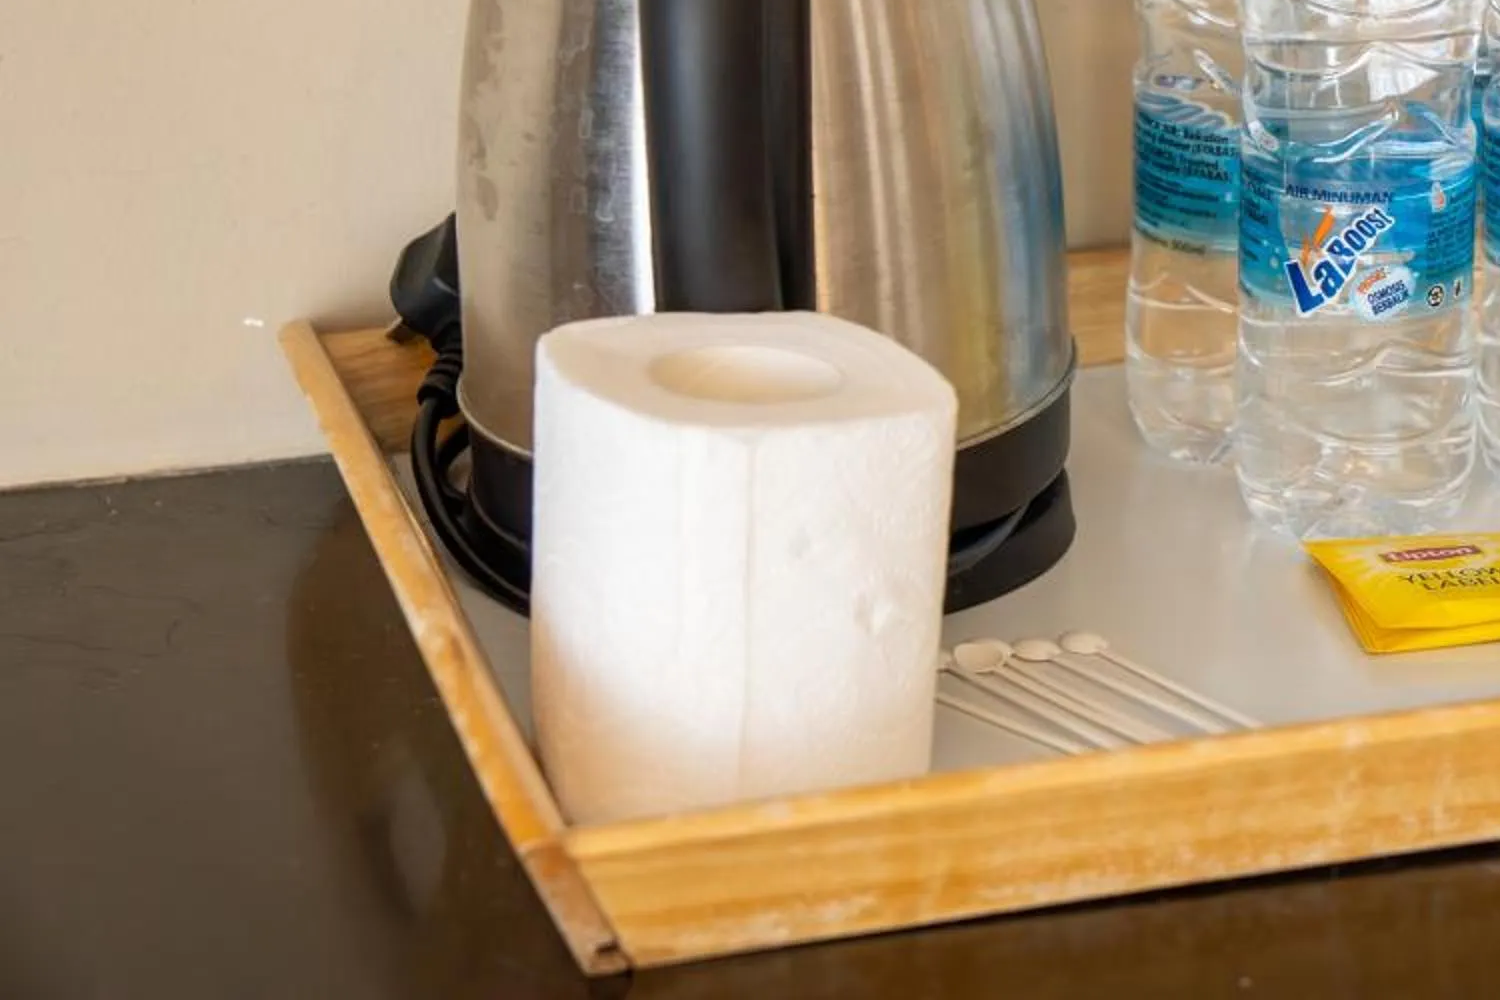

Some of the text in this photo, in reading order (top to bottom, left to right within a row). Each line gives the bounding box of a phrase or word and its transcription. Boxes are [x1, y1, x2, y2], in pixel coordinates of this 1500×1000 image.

[1286, 183, 1394, 204] AIR MINUMAN
[1387, 547, 1474, 561] Lipton
